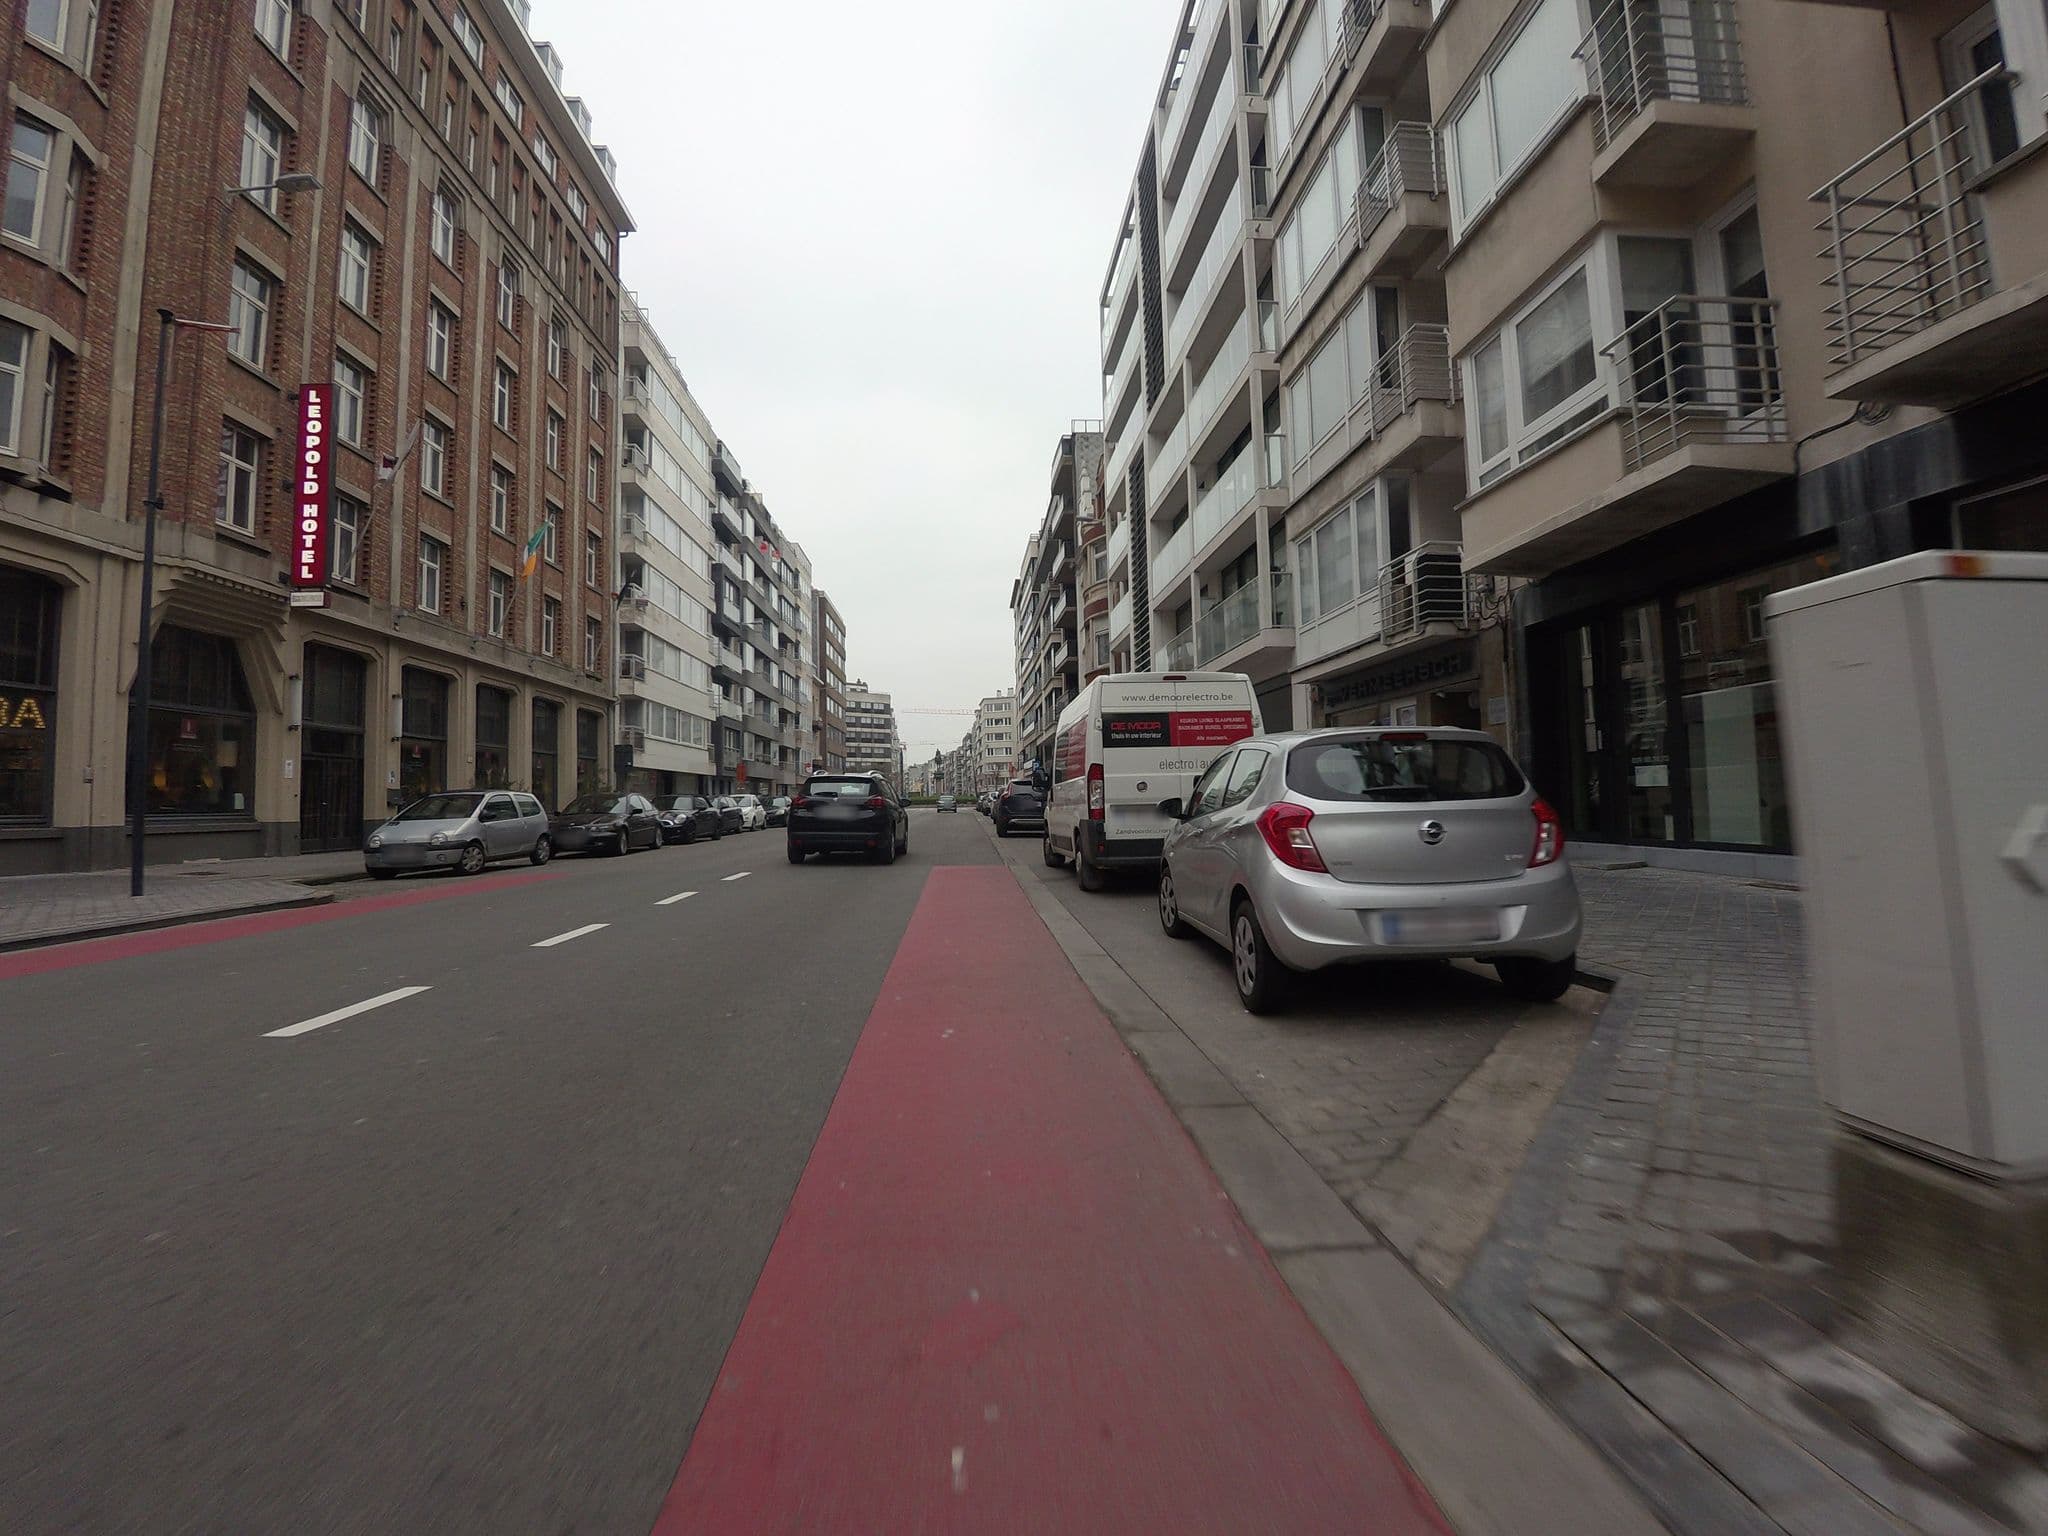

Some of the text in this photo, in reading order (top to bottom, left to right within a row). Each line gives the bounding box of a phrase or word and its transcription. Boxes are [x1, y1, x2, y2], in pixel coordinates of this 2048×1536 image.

[303, 389, 322, 495] LEOPOLD
[301, 504, 319, 579] HOTEL
[1121, 693, 1233, 702] www.demoorelectro.be
[1159, 759, 1194, 770] electro
